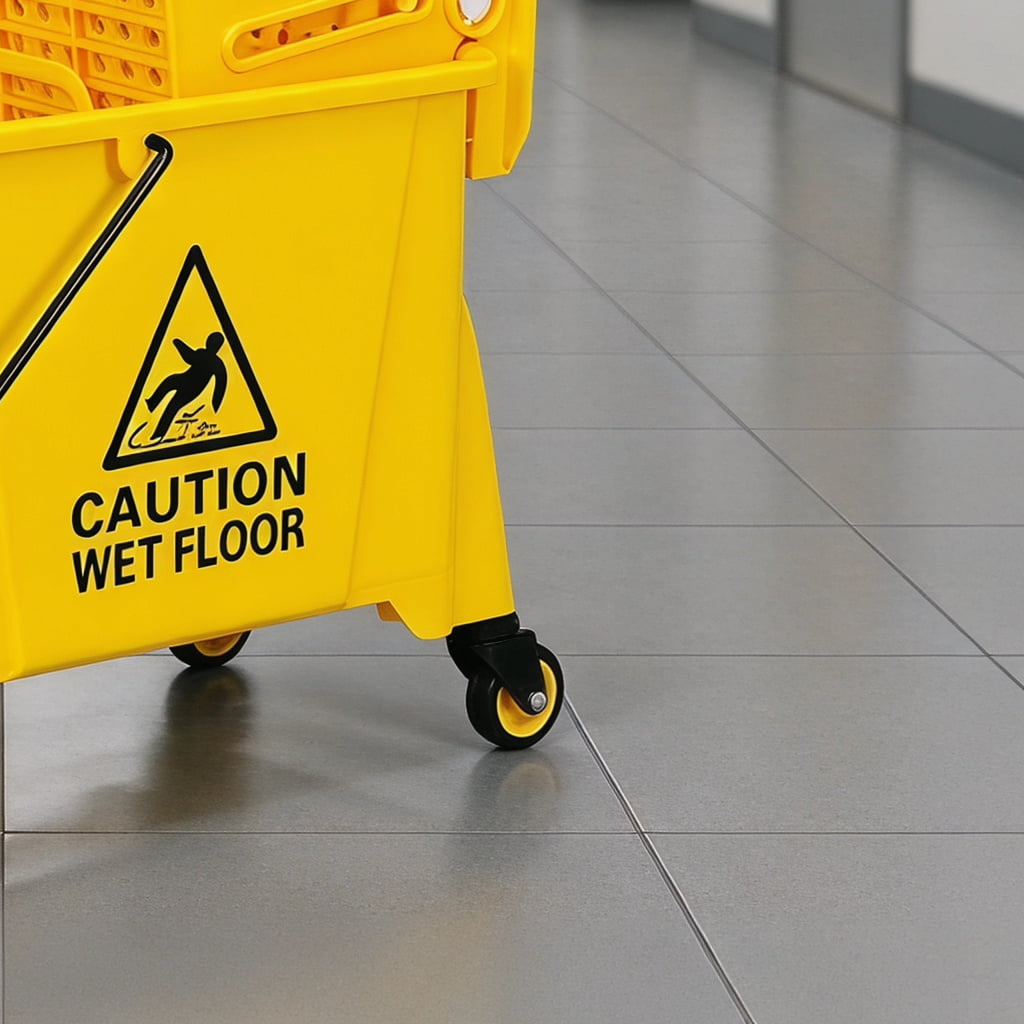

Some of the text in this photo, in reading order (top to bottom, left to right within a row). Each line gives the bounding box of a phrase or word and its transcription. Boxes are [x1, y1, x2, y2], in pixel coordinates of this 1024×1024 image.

[71, 452, 306, 538] CAUTION
[72, 507, 305, 594] WET FLOOR
